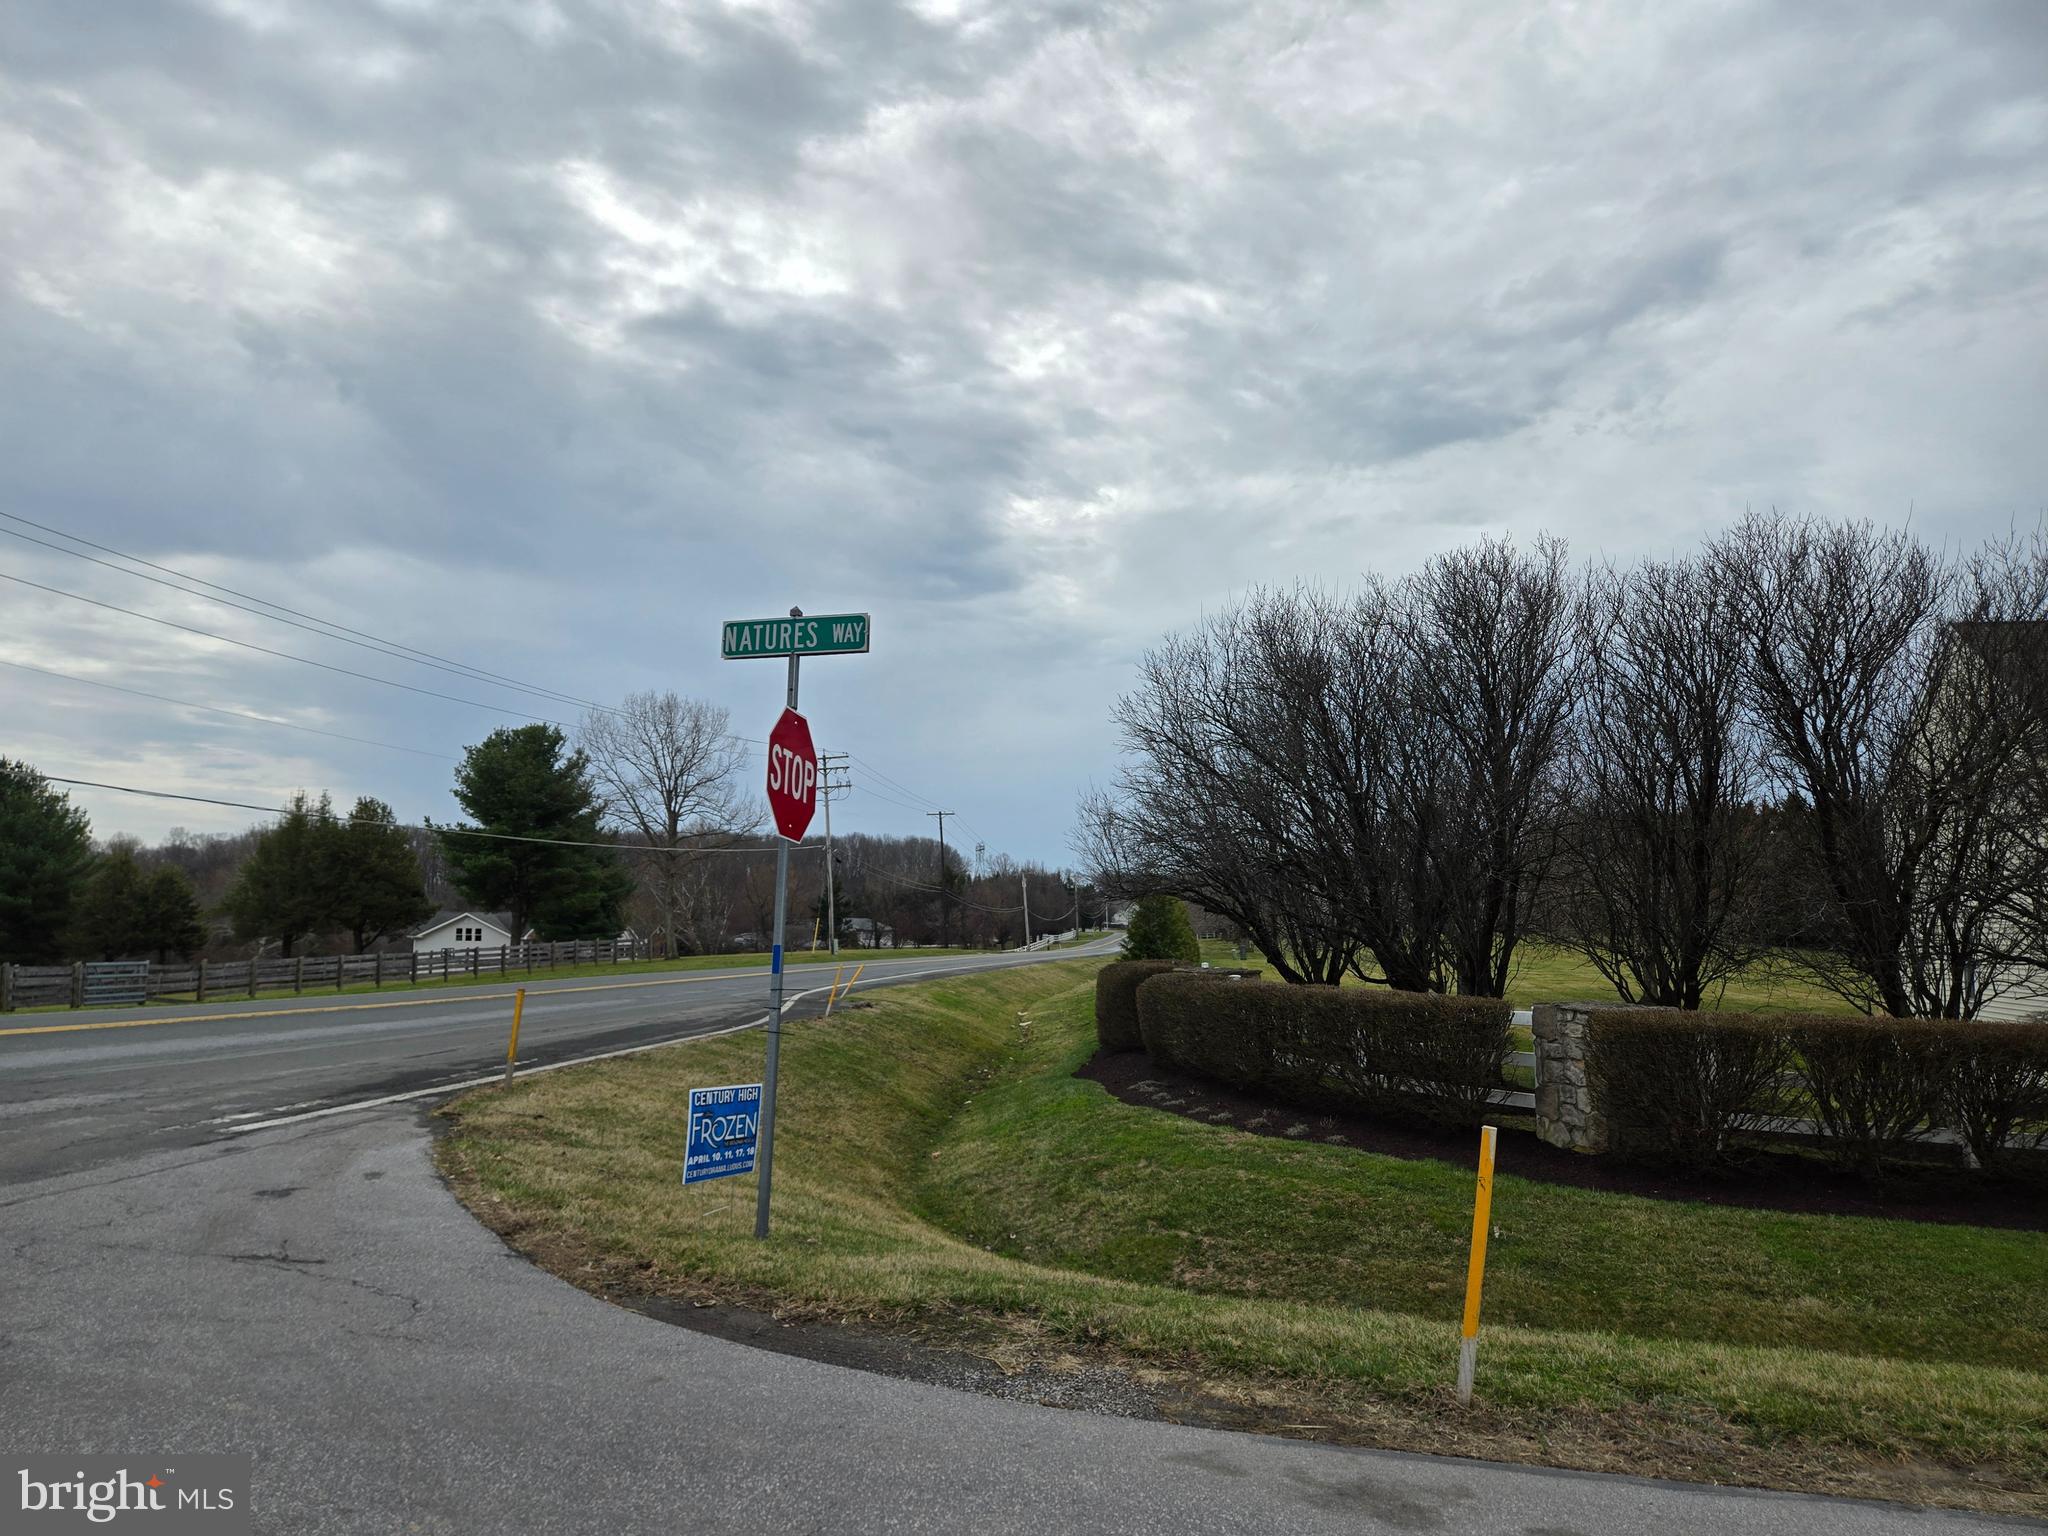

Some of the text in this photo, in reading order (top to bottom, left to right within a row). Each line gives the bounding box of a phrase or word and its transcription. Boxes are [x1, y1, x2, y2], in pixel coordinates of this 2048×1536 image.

[724, 621, 864, 653] NATURES WAY
[770, 743, 815, 804] STOP
[695, 1088, 758, 1106] CENTURY HIGH
[691, 1112, 757, 1148] FROZEN
[688, 1154, 710, 1165] APRIL
